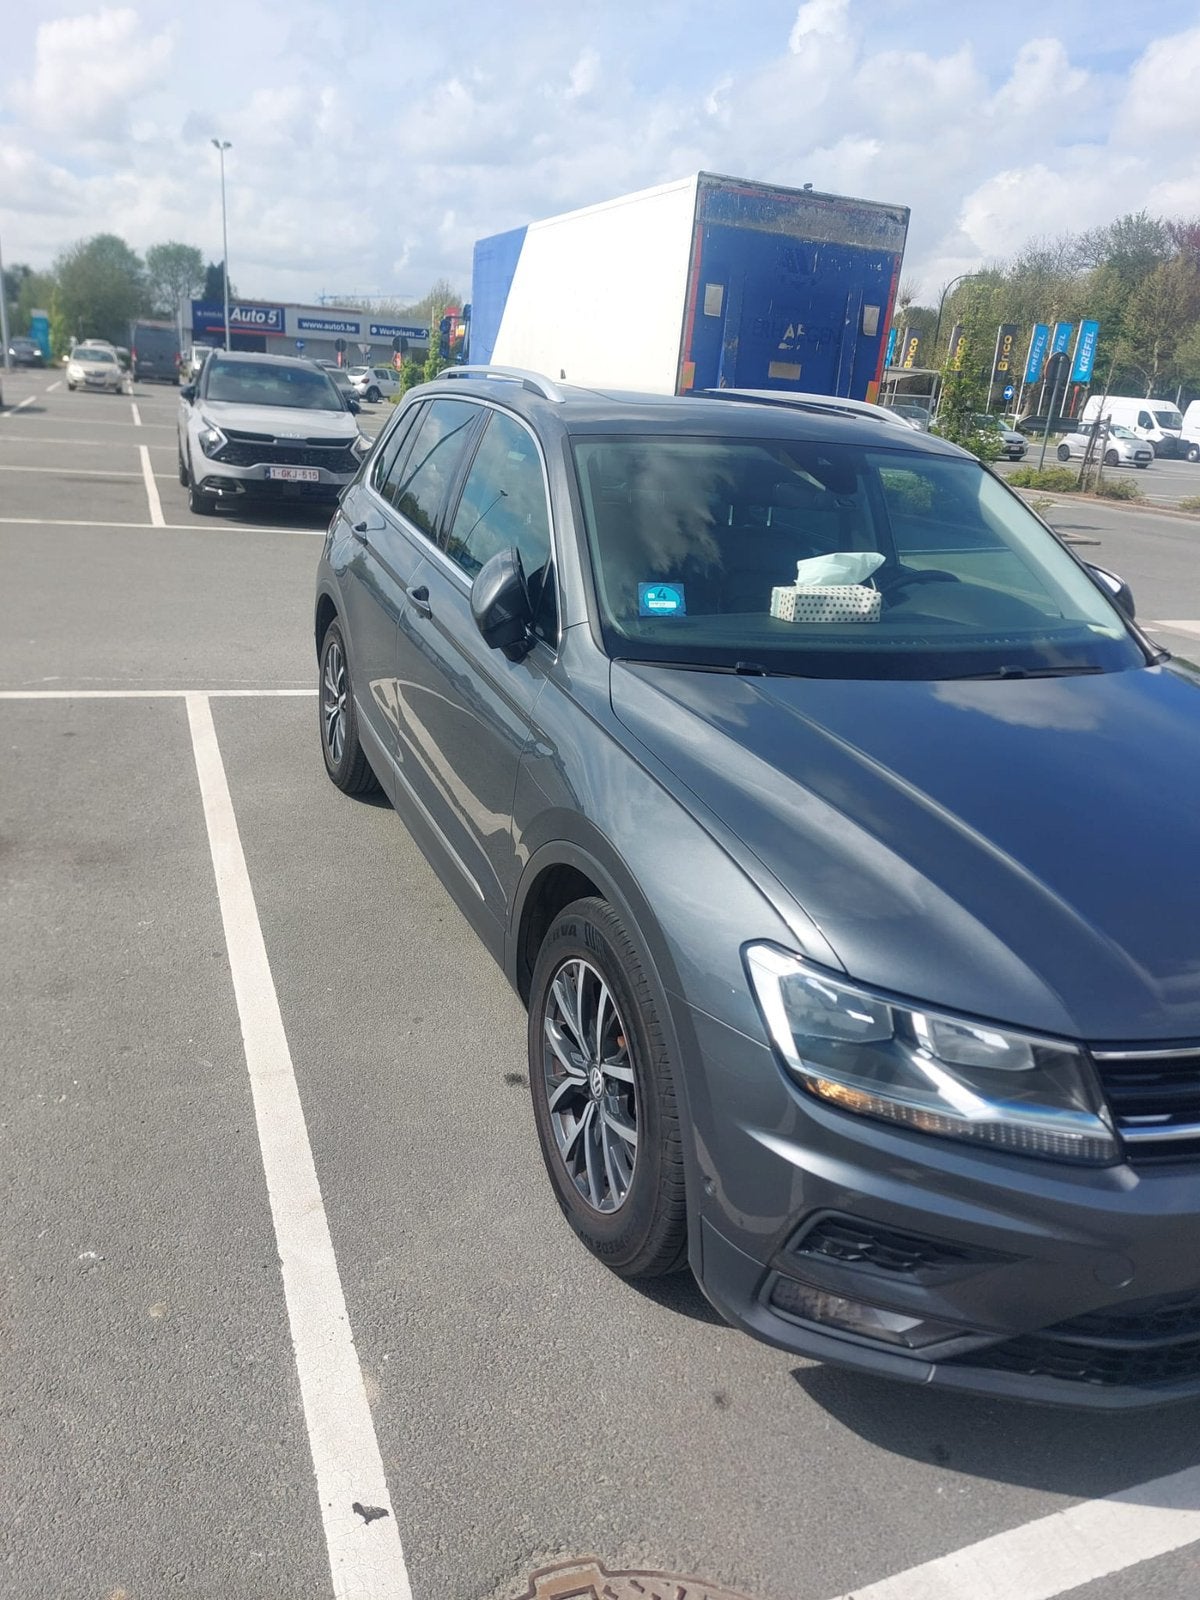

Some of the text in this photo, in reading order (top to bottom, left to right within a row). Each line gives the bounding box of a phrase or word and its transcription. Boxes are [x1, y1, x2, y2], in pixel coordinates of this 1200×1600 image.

[230, 308, 266, 323] Auto
[268, 311, 277, 324] 5
[302, 320, 356, 332] www.auto5.be
[379, 327, 415, 338] Werkplaats
[997, 335, 1013, 371] Brico
